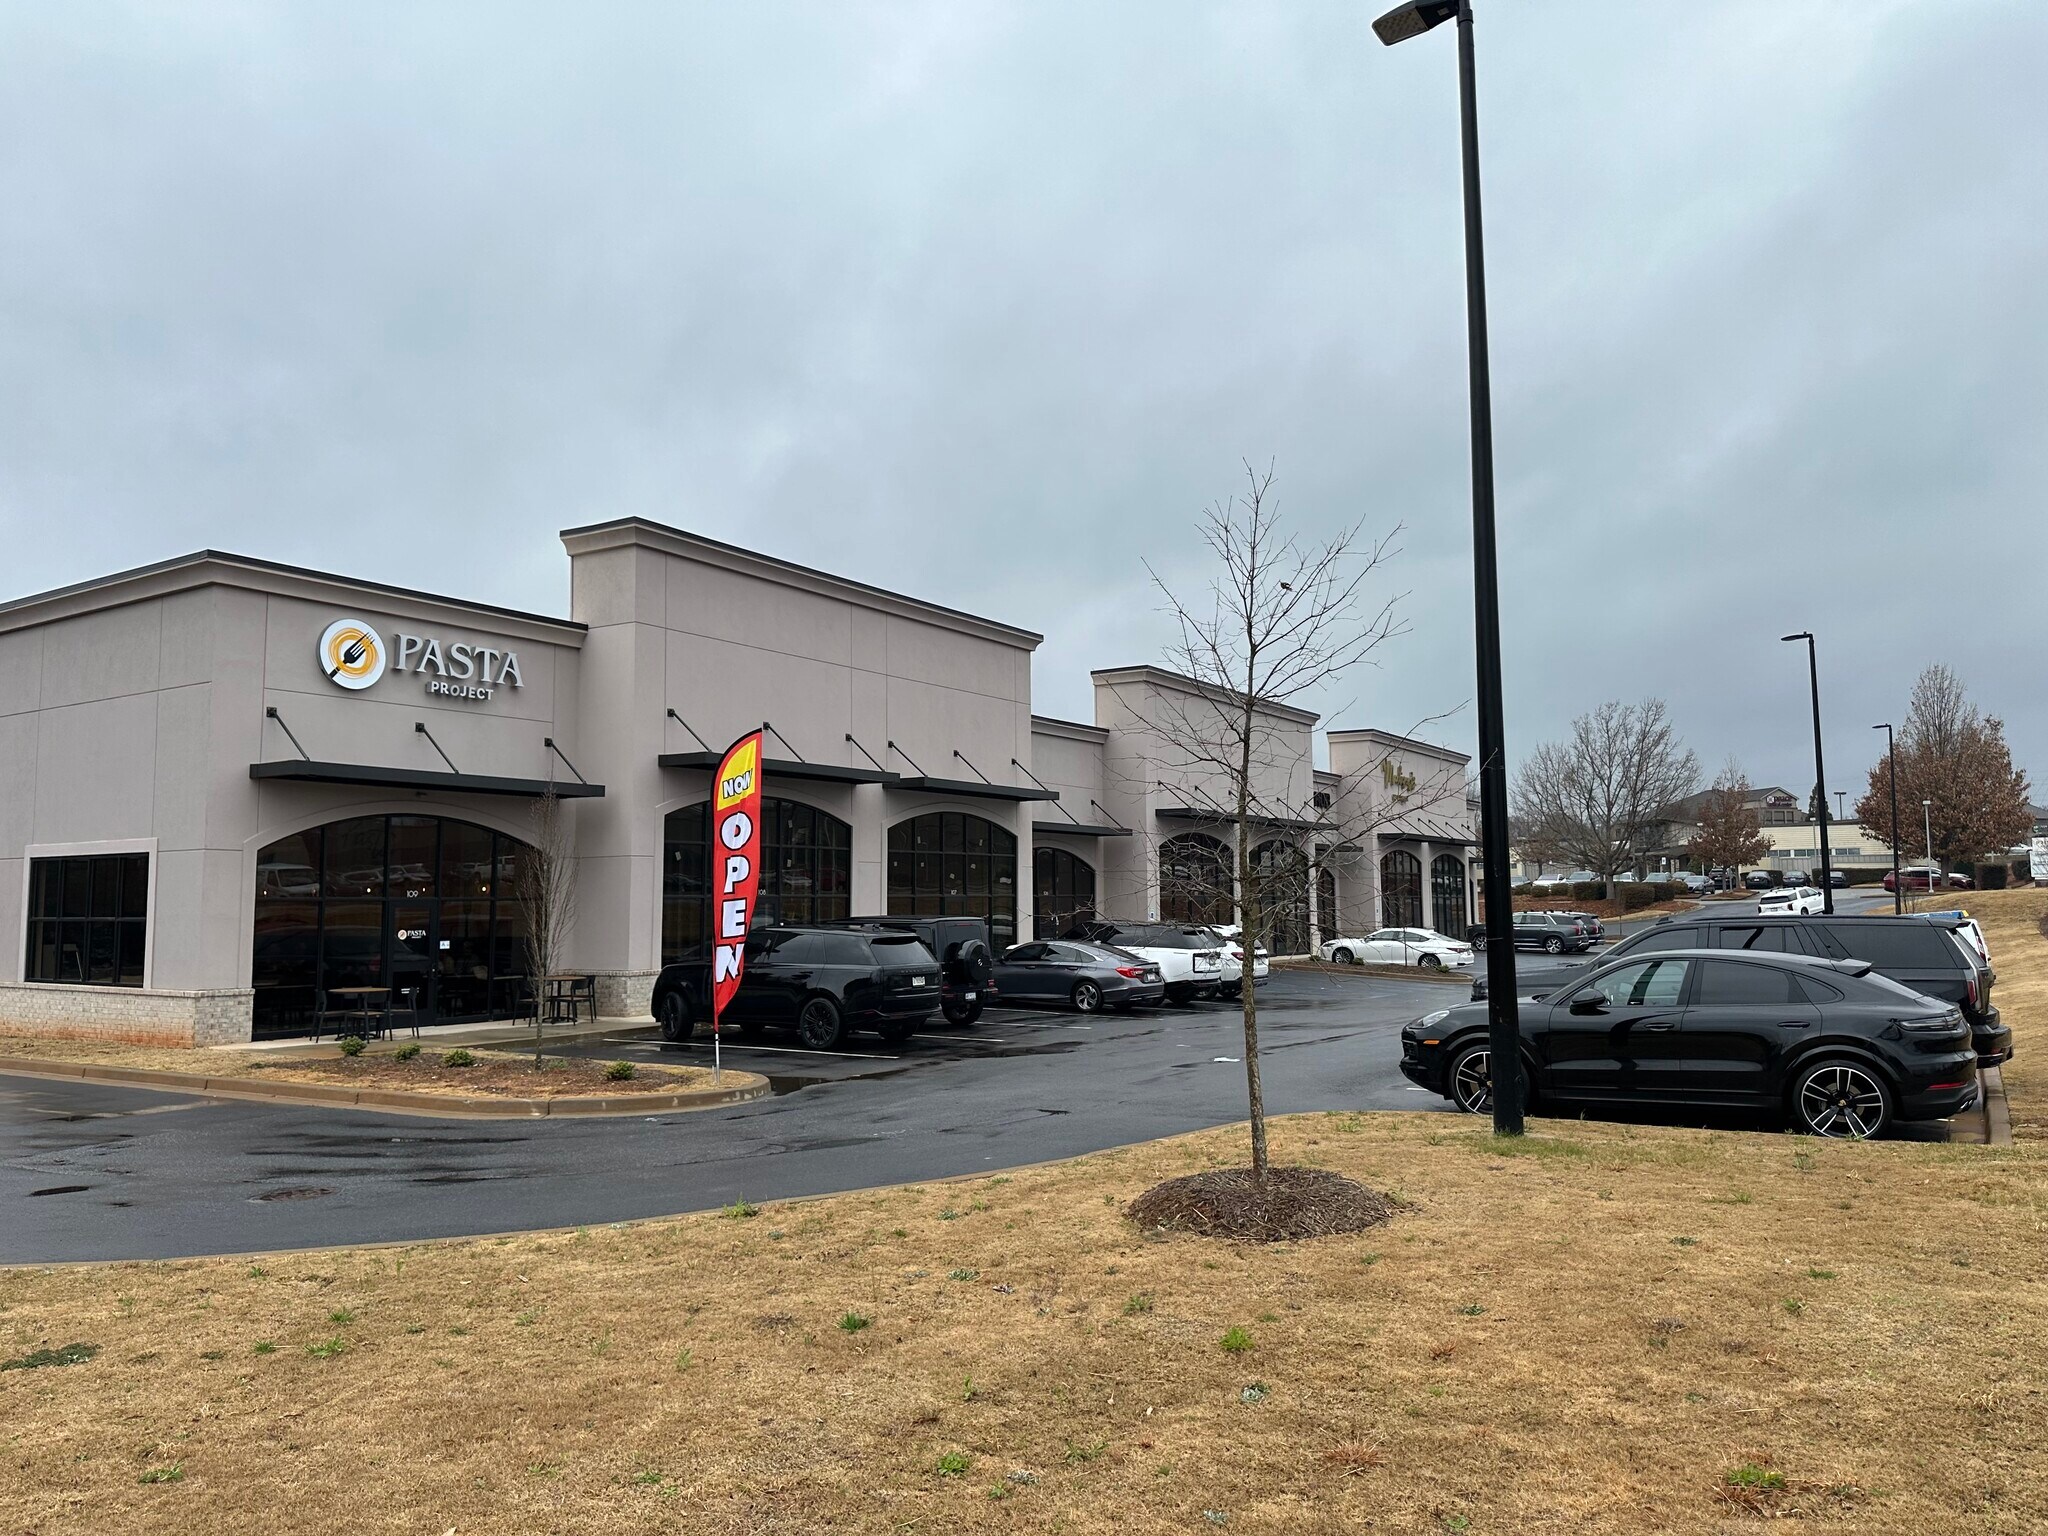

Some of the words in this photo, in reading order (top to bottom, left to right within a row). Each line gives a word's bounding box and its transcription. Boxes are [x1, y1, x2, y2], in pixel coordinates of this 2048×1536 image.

[393, 633, 524, 687] PASTA
[427, 681, 494, 700] PROJECT
[722, 768, 753, 799] NOW
[407, 890, 418, 898] 109
[715, 811, 753, 984] OPEN
